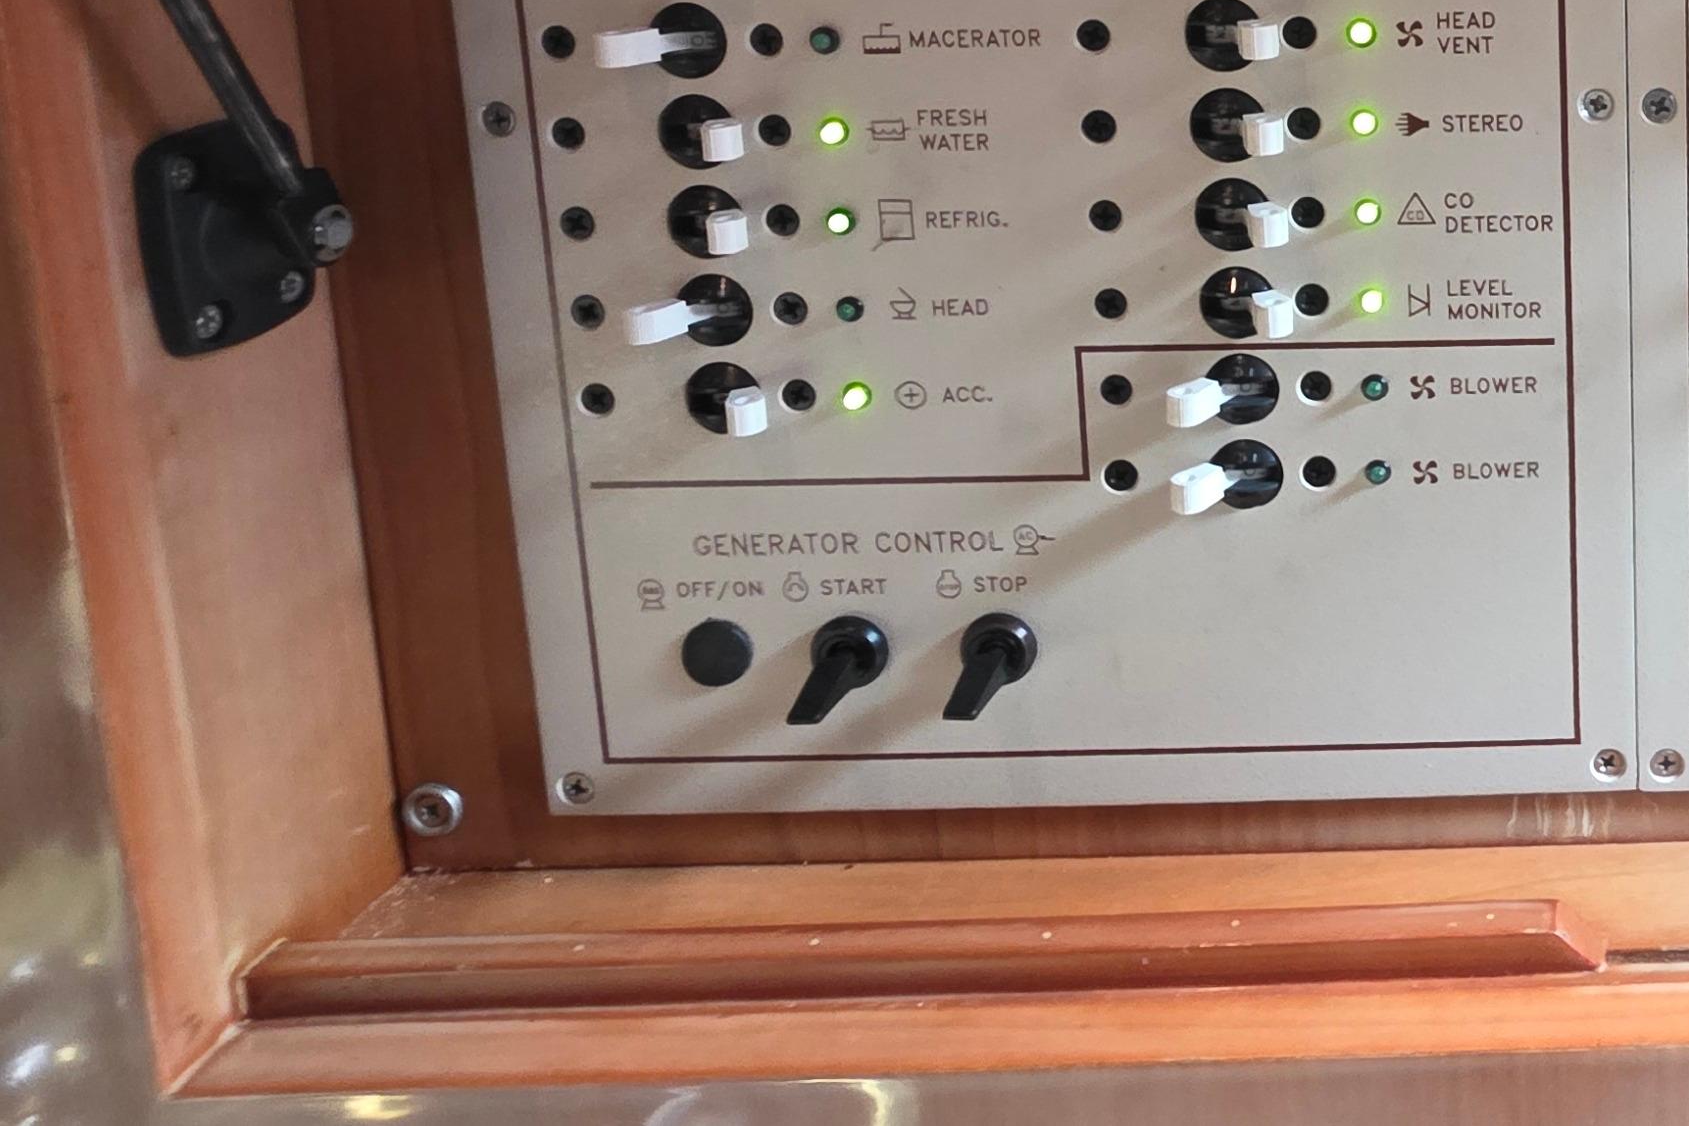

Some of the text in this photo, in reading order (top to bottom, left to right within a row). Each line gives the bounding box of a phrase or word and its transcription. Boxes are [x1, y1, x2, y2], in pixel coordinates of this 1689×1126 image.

[1436, 11, 1496, 30] HEAD
[908, 28, 1041, 49] MACERATOR
[1436, 35, 1494, 55] VENT
[916, 108, 987, 127] FRESH
[1442, 114, 1524, 133] STEREO
[918, 132, 989, 152] WATER
[1444, 192, 1475, 210] CO
[925, 210, 1009, 229] REFRIG.
[1445, 214, 1554, 234] DETECTOR
[1446, 279, 1513, 297] LEVEL
[931, 298, 989, 317] HEAD
[1447, 301, 1542, 320] MONITOR
[942, 385, 993, 403] ACC.
[1450, 376, 1538, 395] BLOWER
[1452, 461, 1540, 480] BLOWER
[693, 530, 1004, 558] GENERATOR CONTROL
[676, 580, 765, 602] OFF/ON
[820, 577, 887, 596] START
[973, 575, 1028, 593] STOP
